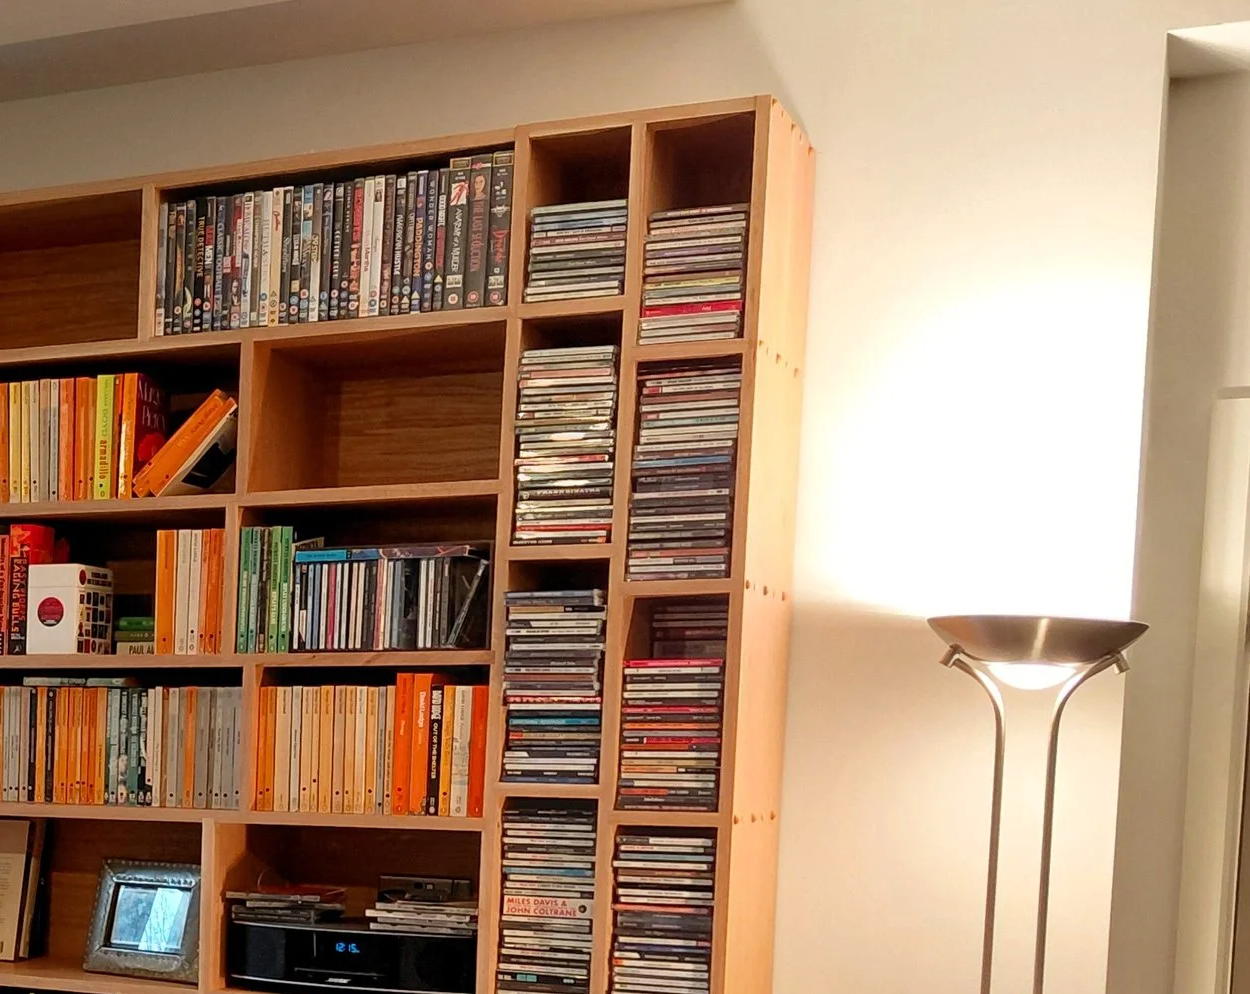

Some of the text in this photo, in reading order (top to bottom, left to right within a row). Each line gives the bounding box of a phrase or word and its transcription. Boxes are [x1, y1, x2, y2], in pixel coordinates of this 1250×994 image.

[472, 216, 484, 231] LAST
[204, 245, 213, 265] MEN
[393, 215, 403, 275] AMERICAN HUSTLE
[413, 217, 423, 276] PADDINGTON
[426, 225, 434, 259] WOMAN
[99, 440, 108, 479] armadillo
[11, 559, 22, 632] RAGING BULLS
[129, 645, 144, 654] PAUL
[534, 908, 576, 916] COLTRANE
